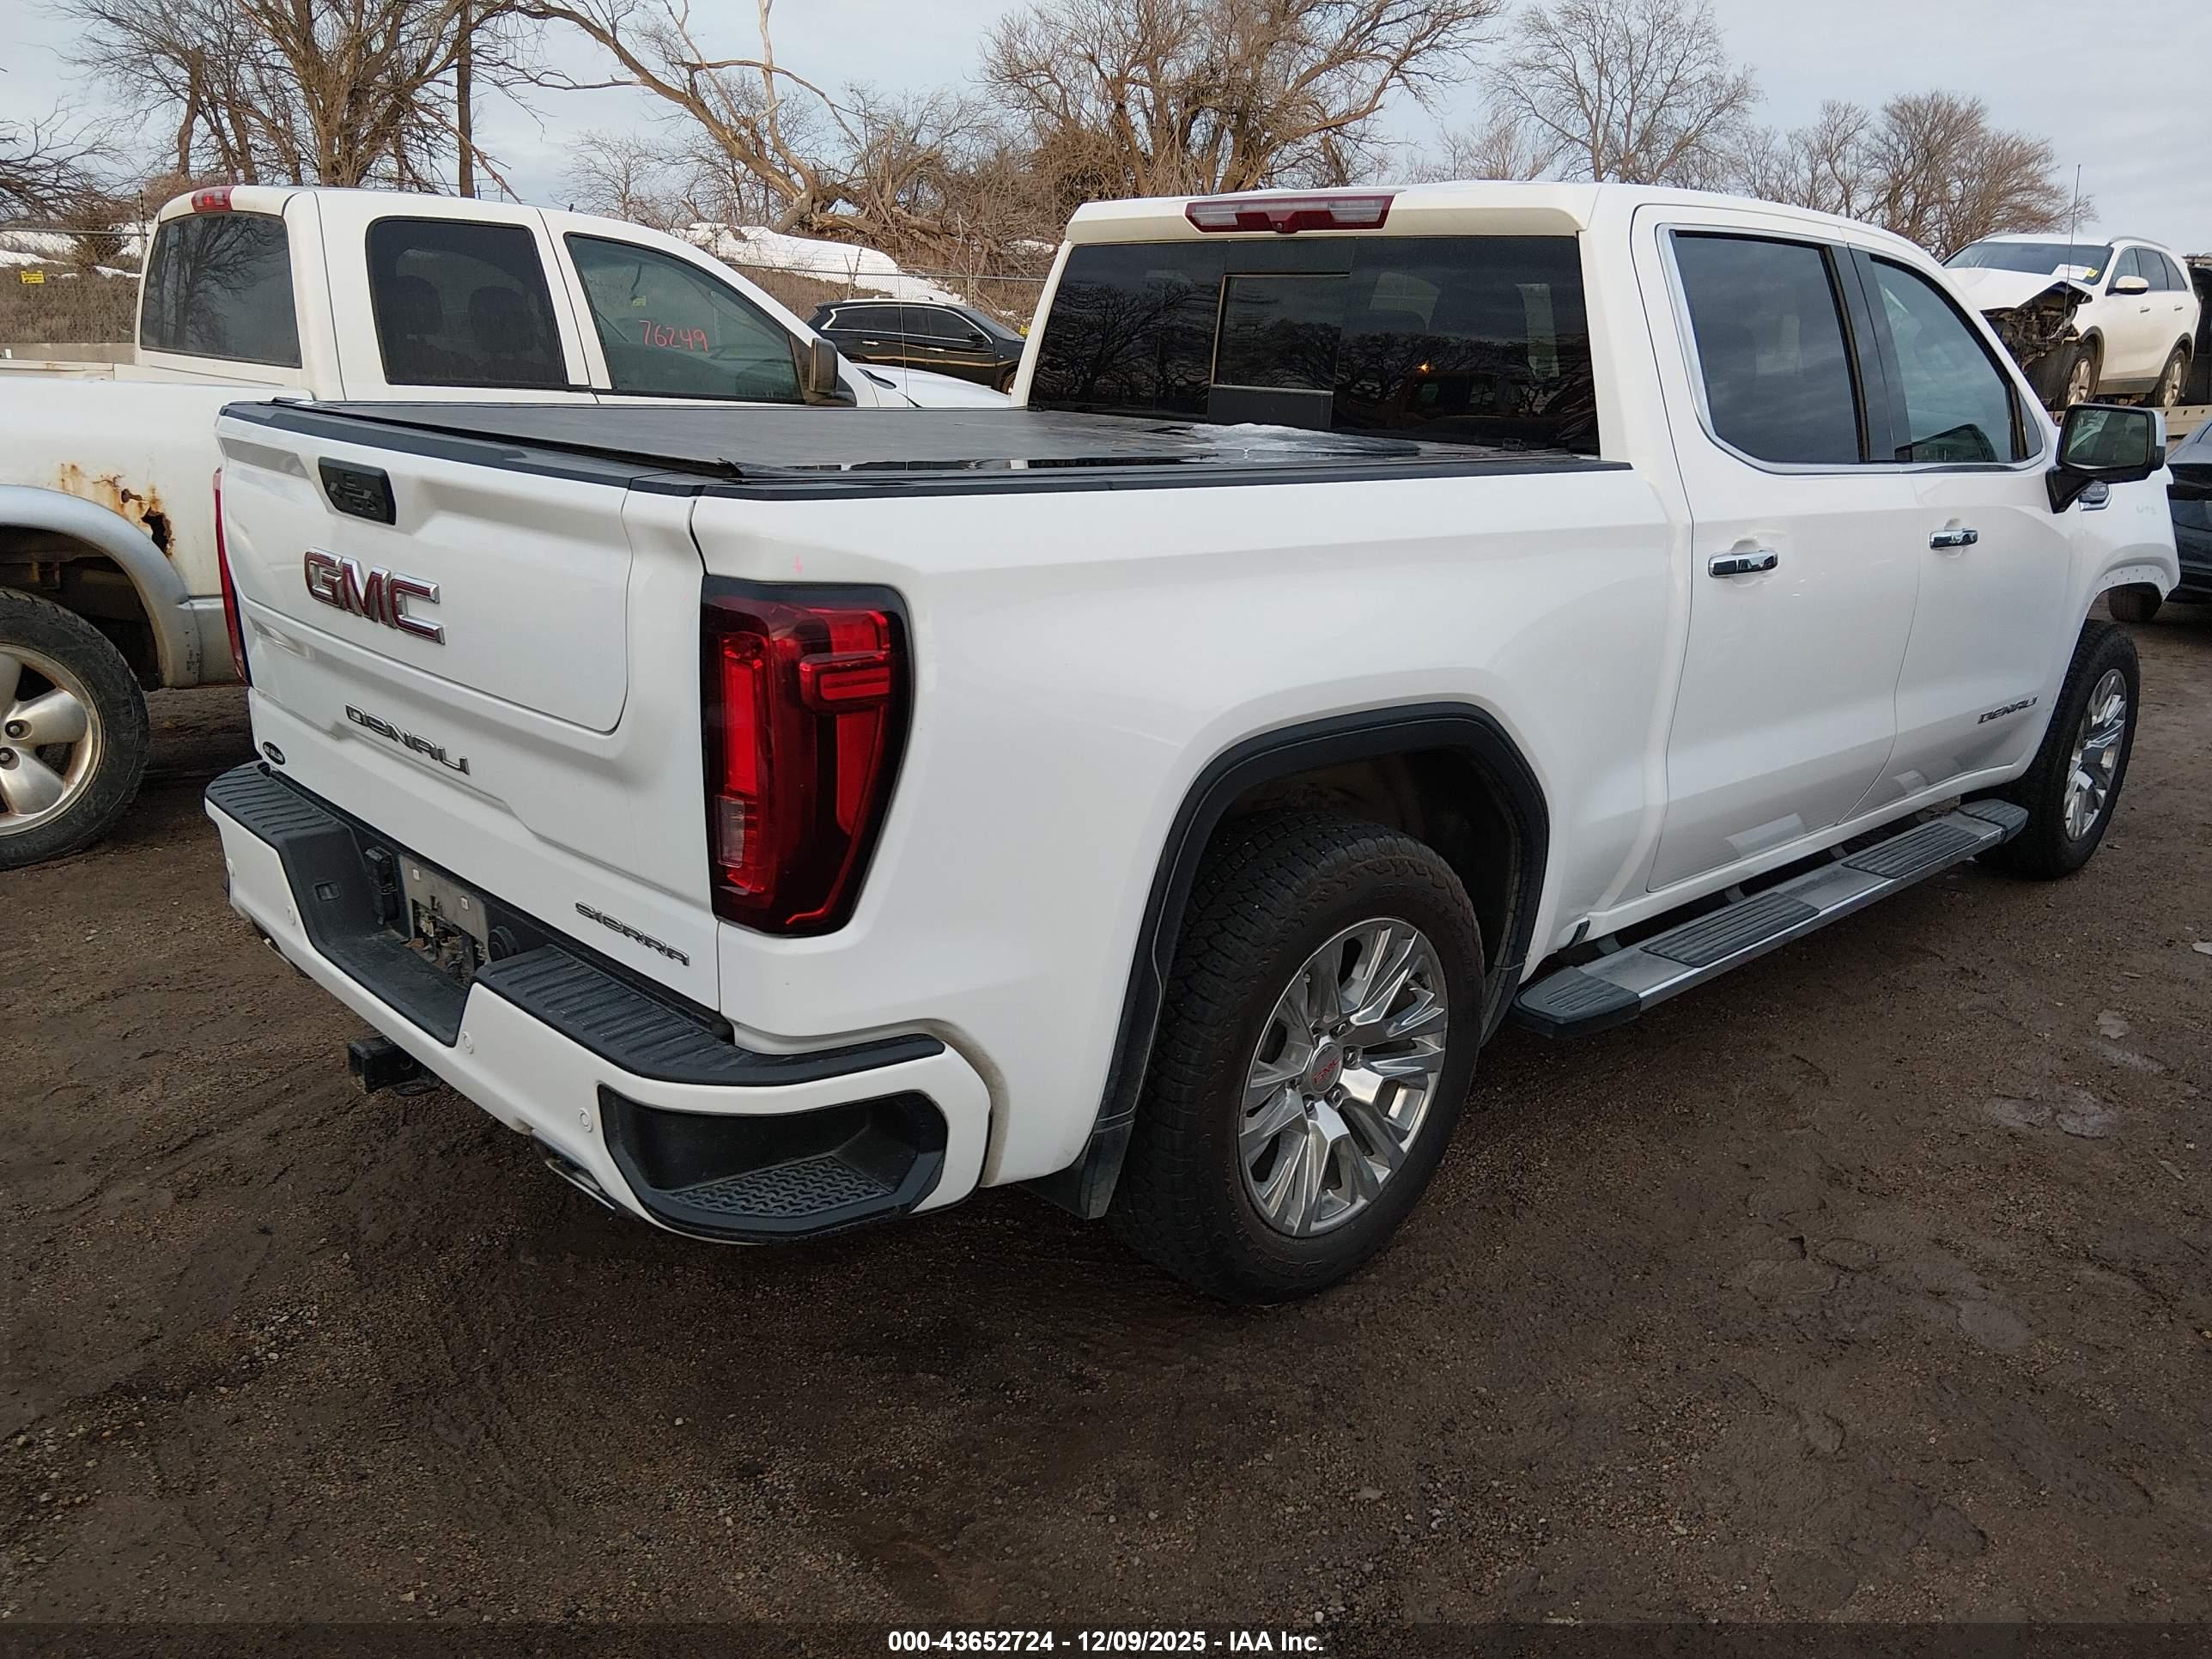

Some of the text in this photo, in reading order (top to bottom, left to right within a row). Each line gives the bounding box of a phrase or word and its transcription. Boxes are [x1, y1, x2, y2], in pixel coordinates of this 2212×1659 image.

[638, 319, 709, 352] 76249
[304, 546, 446, 646] GMC
[345, 702, 471, 776] DENALI
[1978, 695, 2039, 725] DENALI
[574, 901, 690, 966] SIERRA
